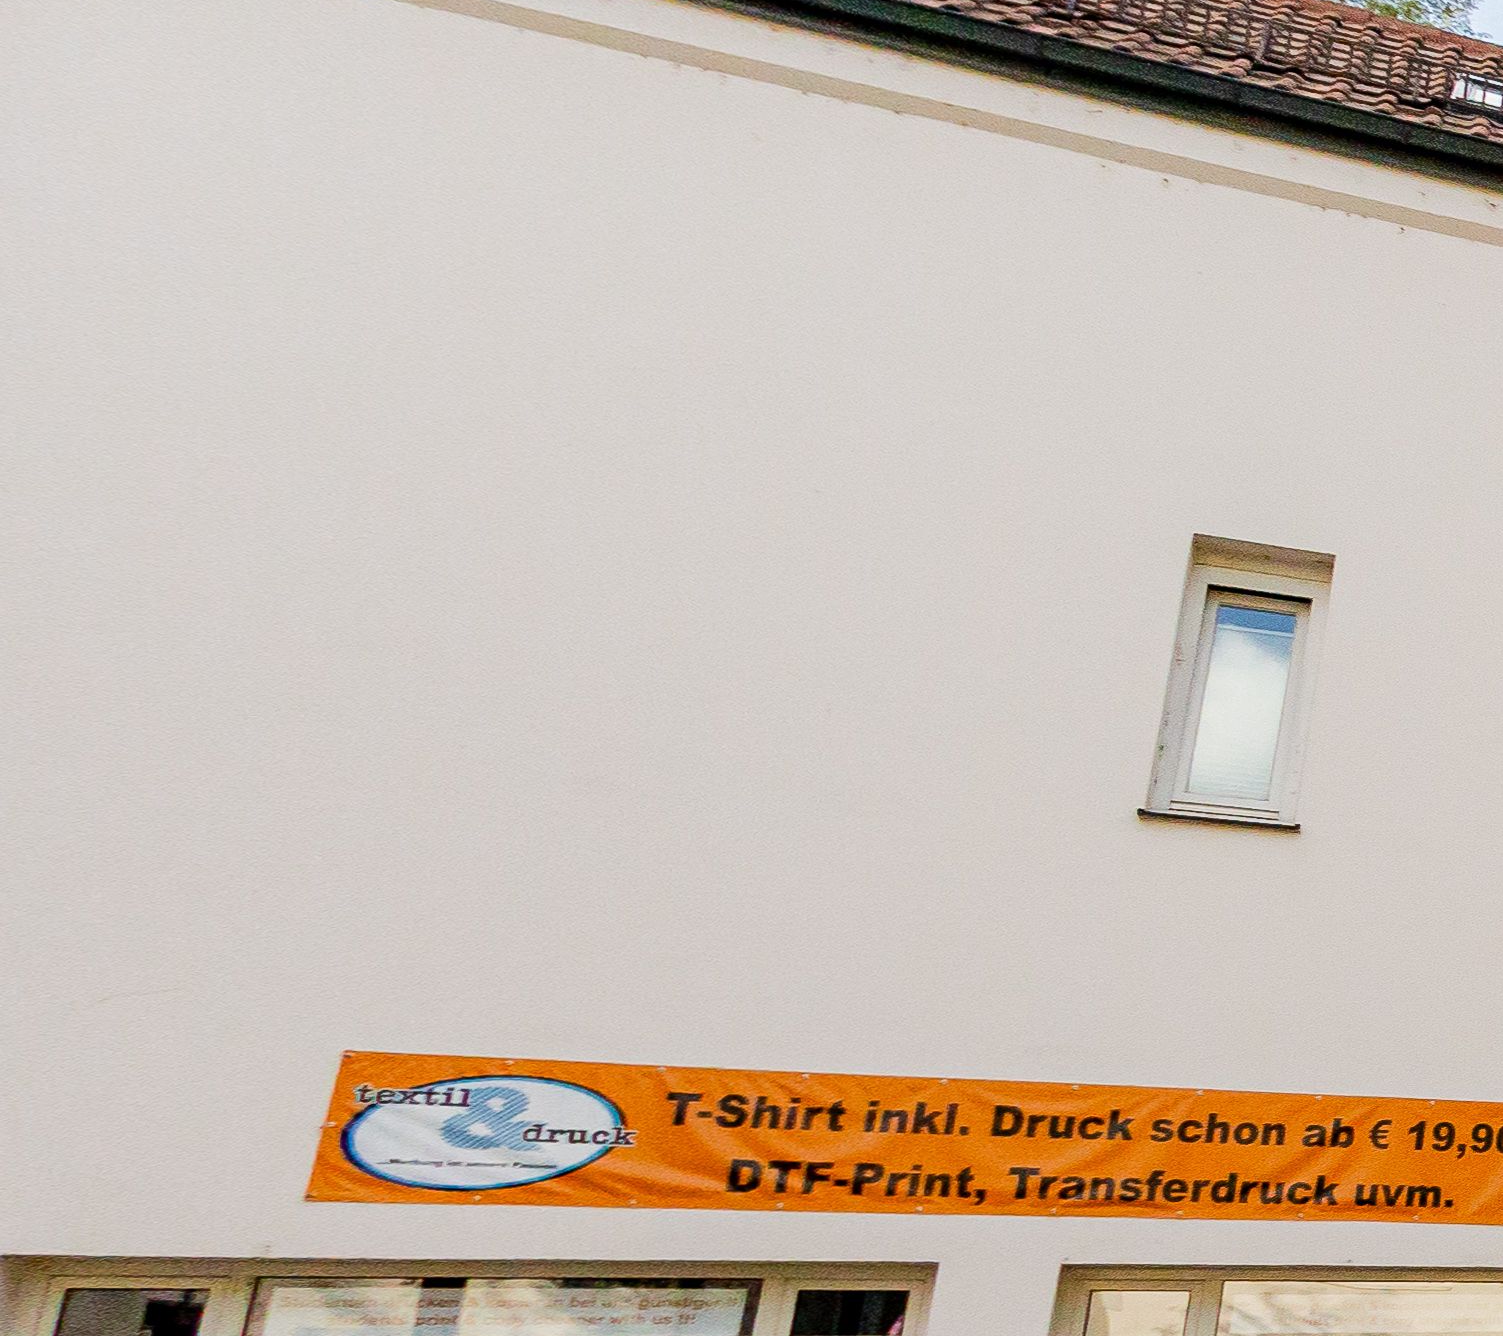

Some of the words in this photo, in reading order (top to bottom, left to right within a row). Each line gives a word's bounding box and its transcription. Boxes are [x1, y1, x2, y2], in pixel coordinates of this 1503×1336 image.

[356, 1085, 471, 1108] textil
[523, 1123, 637, 1145] druck
[667, 1092, 847, 1132] T-Shirt
[864, 1100, 969, 1136] inkl.
[990, 1104, 1133, 1142] Druck
[1150, 1113, 1287, 1146] schon
[1302, 1118, 1355, 1149] ab
[1369, 1119, 1392, 1150] €
[726, 1159, 987, 1206] DTF-Print,
[1009, 1167, 1338, 1207] Transferdruck
[1354, 1183, 1454, 1208] uvm.
